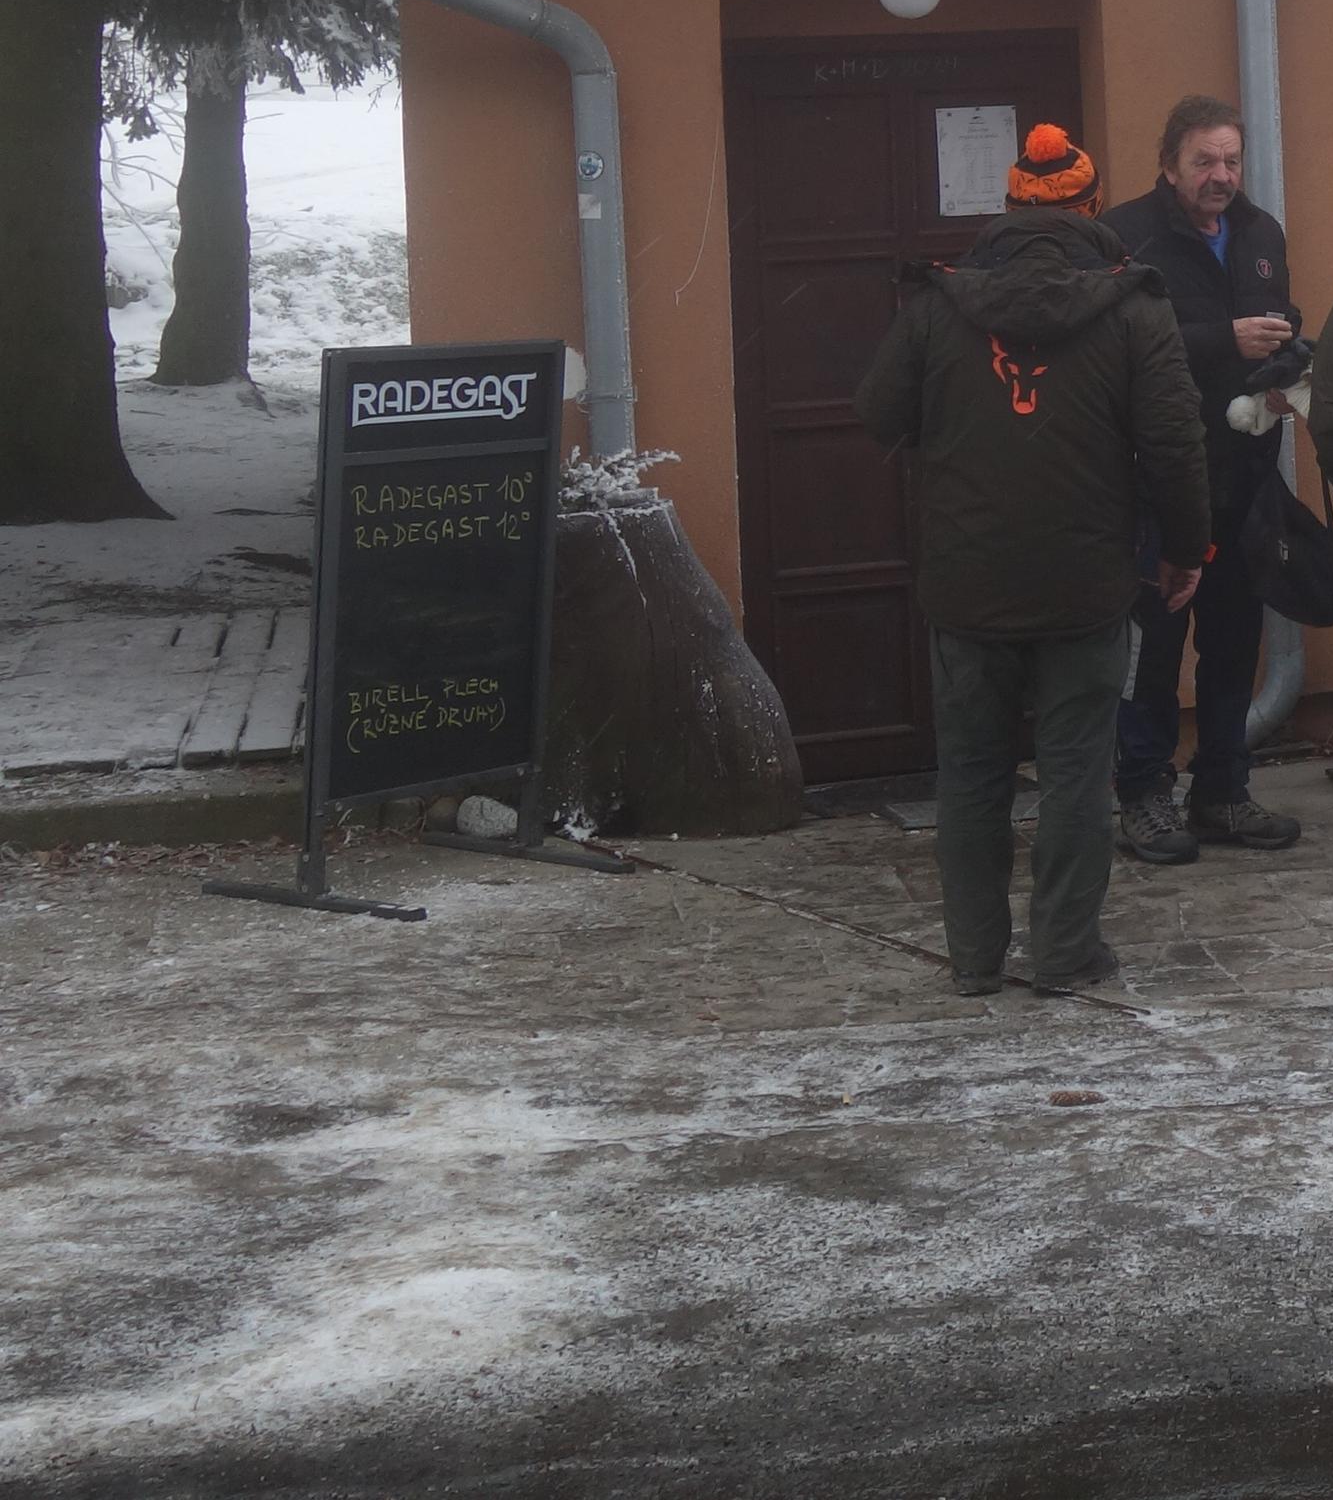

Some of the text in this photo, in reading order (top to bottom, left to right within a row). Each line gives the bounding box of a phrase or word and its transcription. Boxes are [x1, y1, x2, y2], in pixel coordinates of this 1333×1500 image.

[352, 372, 537, 427] RADEGAST
[351, 482, 490, 516] RADEGAST
[354, 515, 490, 548] RADEGAST
[348, 678, 499, 714] BIRELL PLECH
[436, 697, 506, 732] DRUHY)
